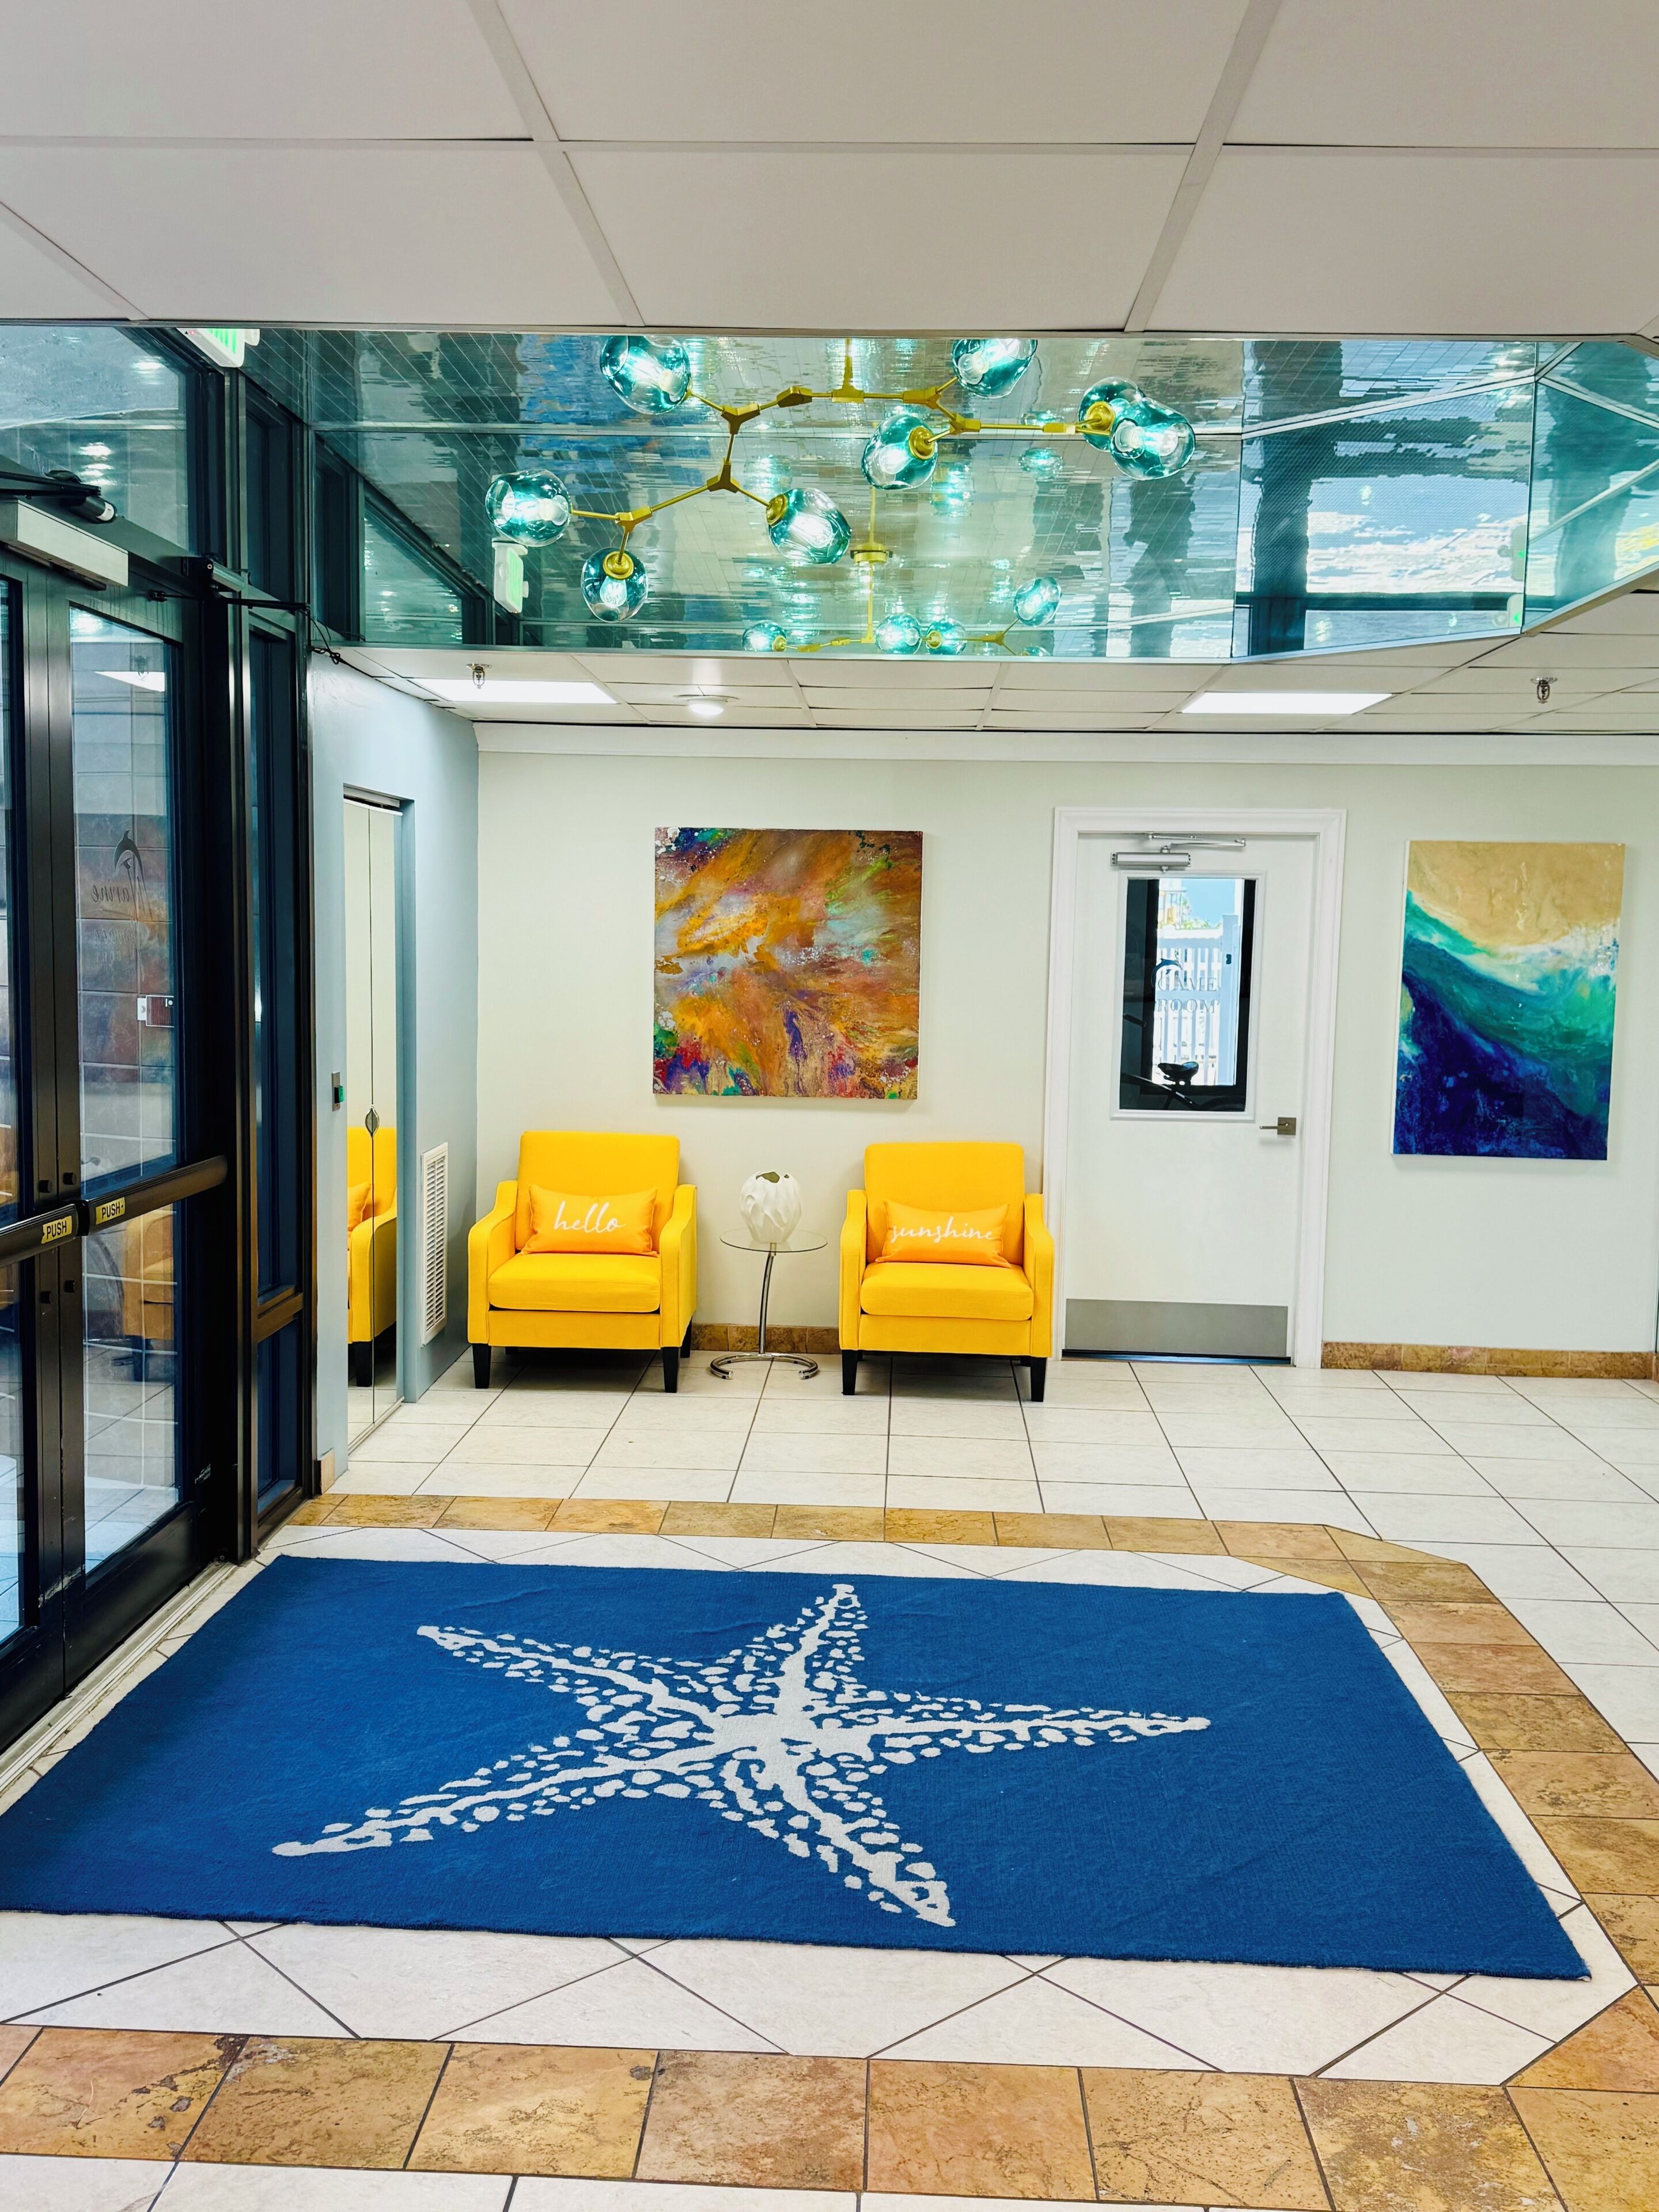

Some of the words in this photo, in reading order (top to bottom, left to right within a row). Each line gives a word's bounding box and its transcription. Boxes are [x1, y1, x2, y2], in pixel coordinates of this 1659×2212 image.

[1156, 998, 1216, 1014] ROOM
[101, 1201, 120, 1220] PUSH
[554, 1200, 626, 1234] hello
[47, 1220, 67, 1240] PUSH
[891, 1215, 998, 1244] sunshine
